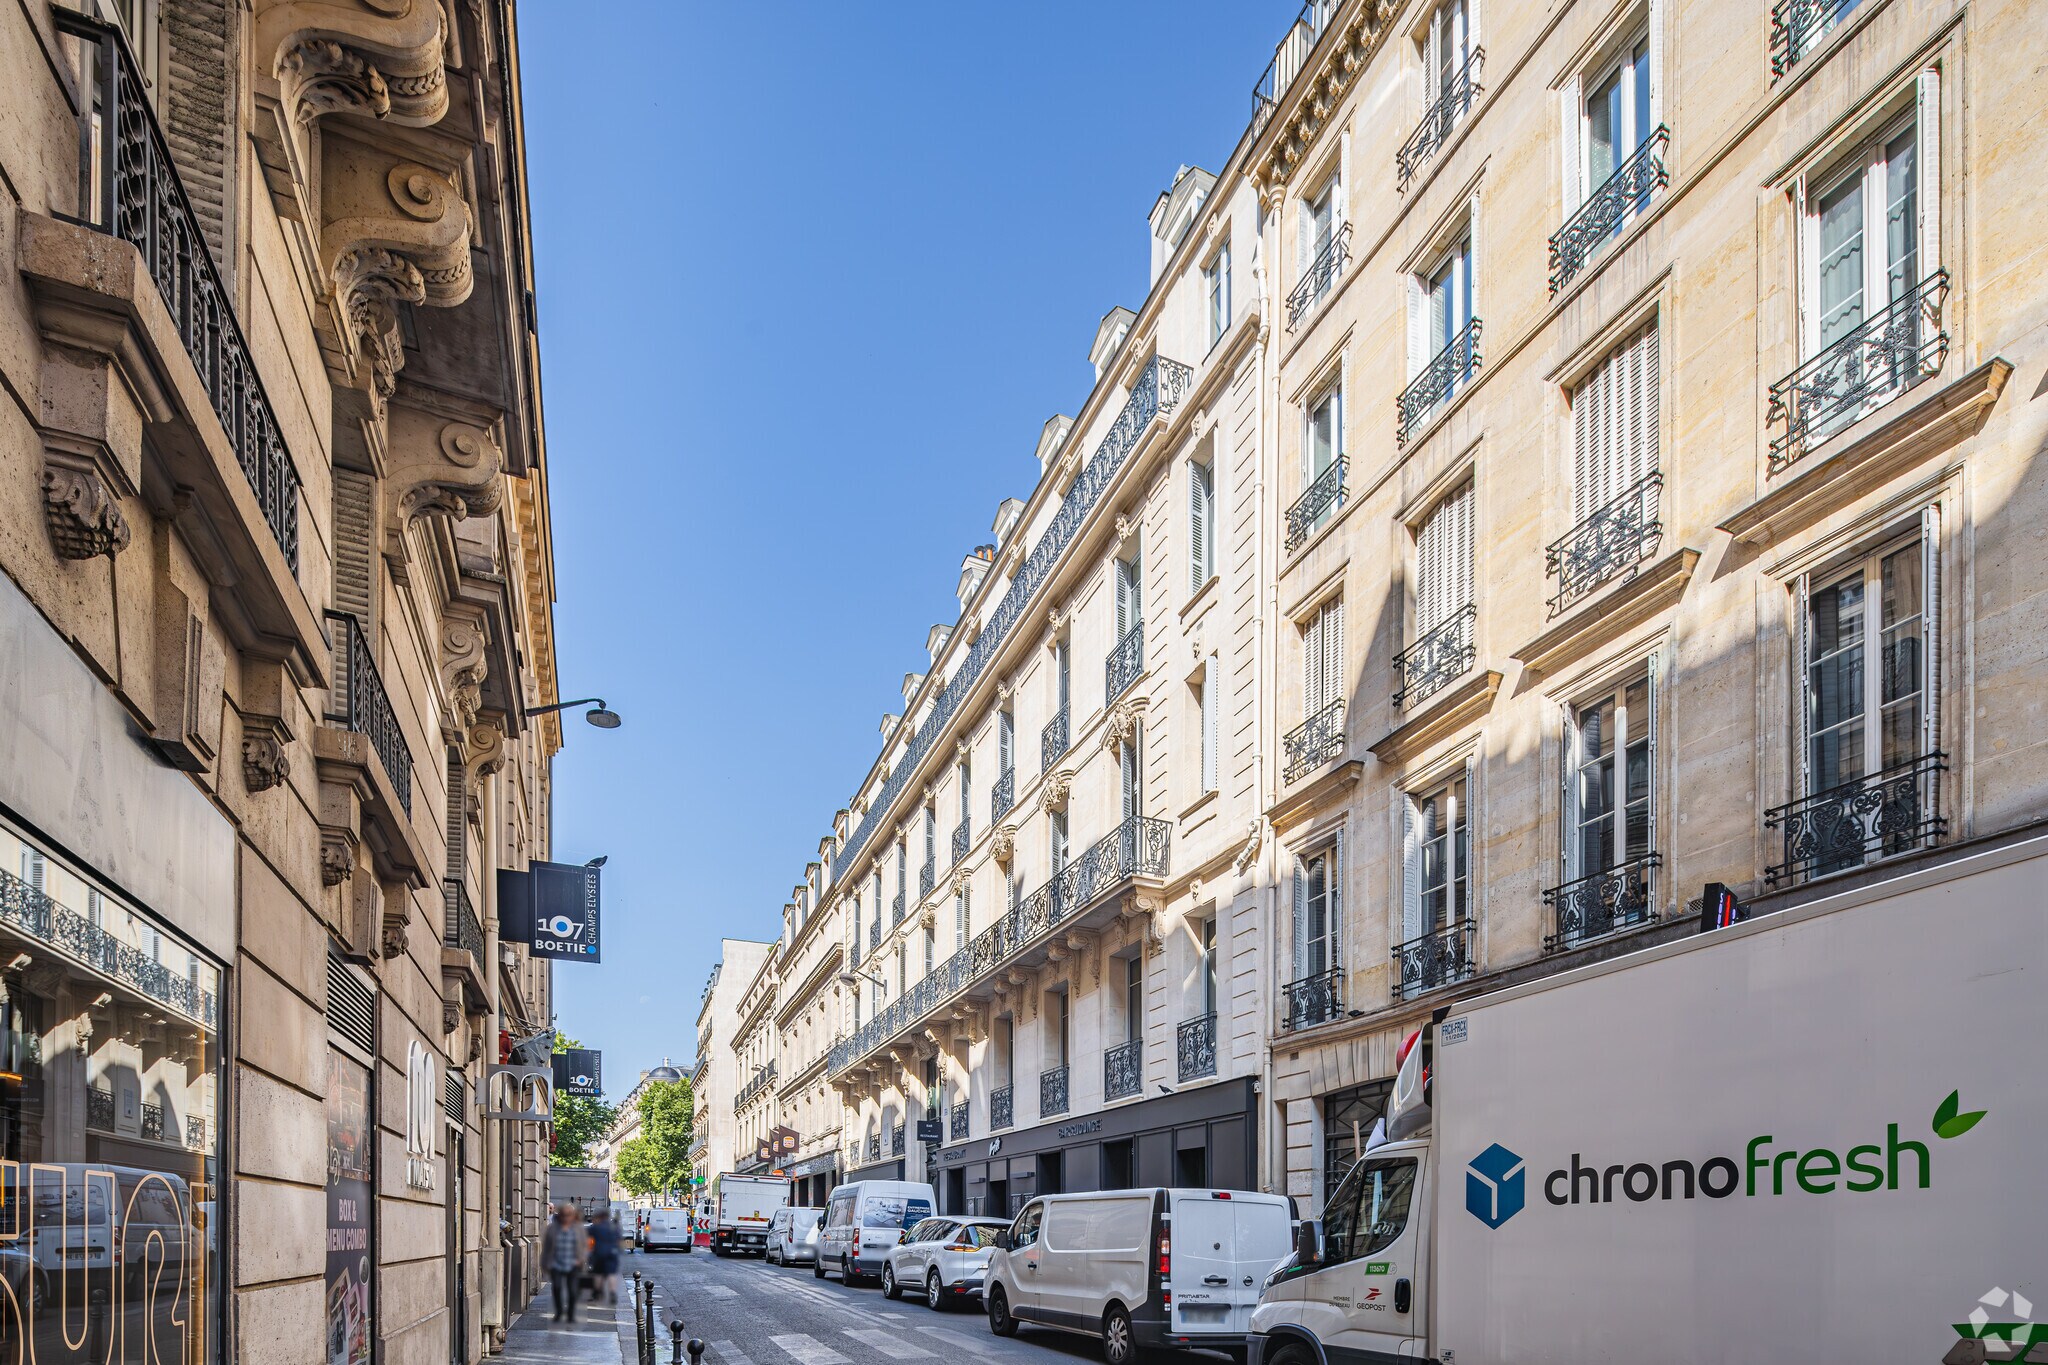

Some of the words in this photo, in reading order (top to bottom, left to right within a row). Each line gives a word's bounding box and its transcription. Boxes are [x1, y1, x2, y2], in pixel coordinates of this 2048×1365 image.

[587, 873, 597, 908] ELYSEES
[537, 915, 585, 940] 107
[587, 909, 597, 945] CHAMPS
[534, 939, 587, 954] BOETIE
[570, 1074, 594, 1087] 107
[1544, 1123, 1931, 1206] chronofresh
[338, 1198, 352, 1222] BOX
[327, 1228, 346, 1252] MENU
[346, 1228, 367, 1251] COMBO
[1356, 1302, 1387, 1312] GEOPOST
